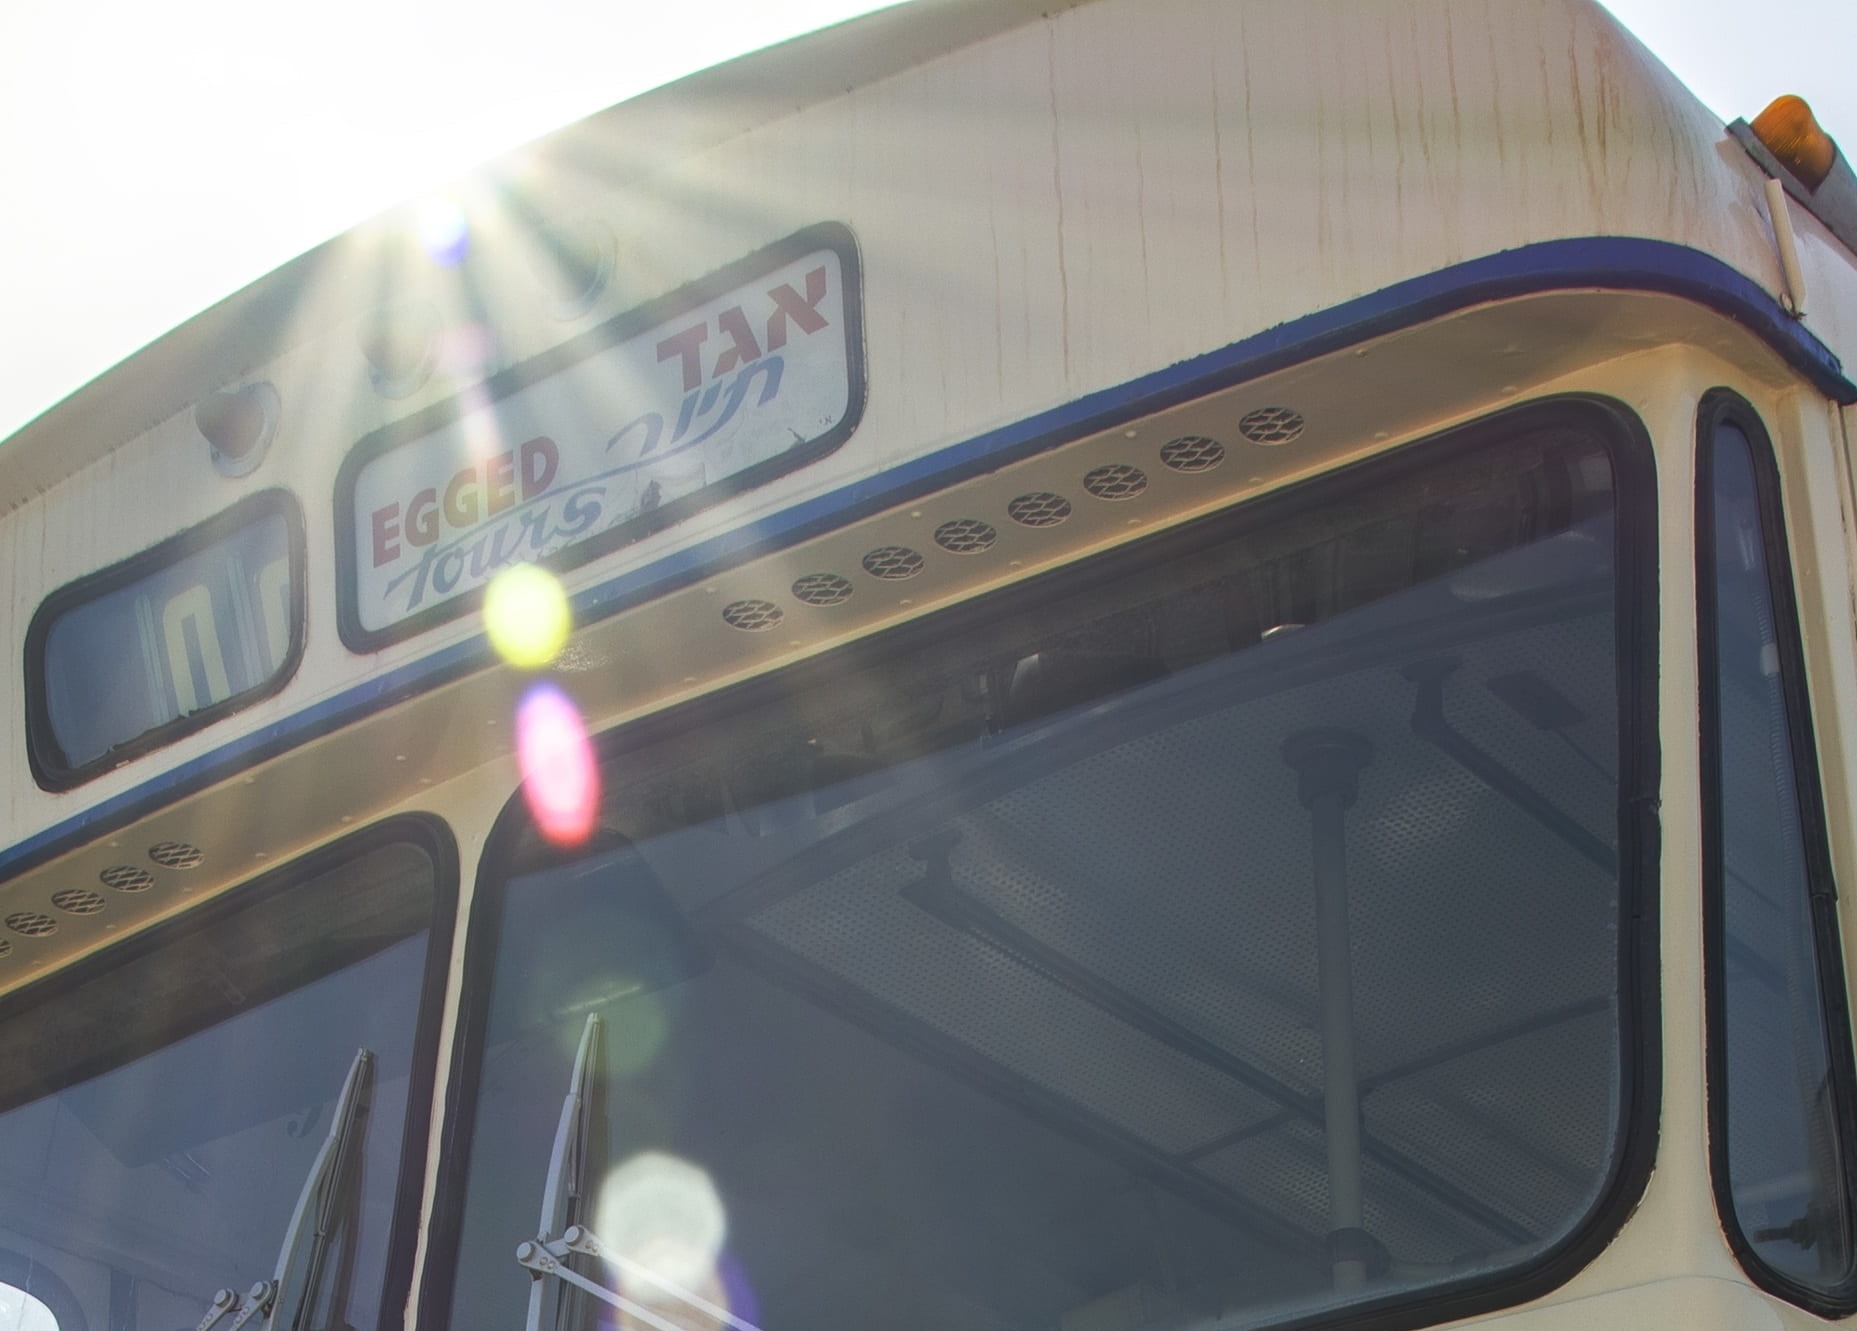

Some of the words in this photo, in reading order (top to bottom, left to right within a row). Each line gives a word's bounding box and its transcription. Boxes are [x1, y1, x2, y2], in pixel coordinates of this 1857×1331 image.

[656, 265, 830, 393] אגד
[371, 435, 560, 569] EGGED
[383, 486, 607, 613] Tours
